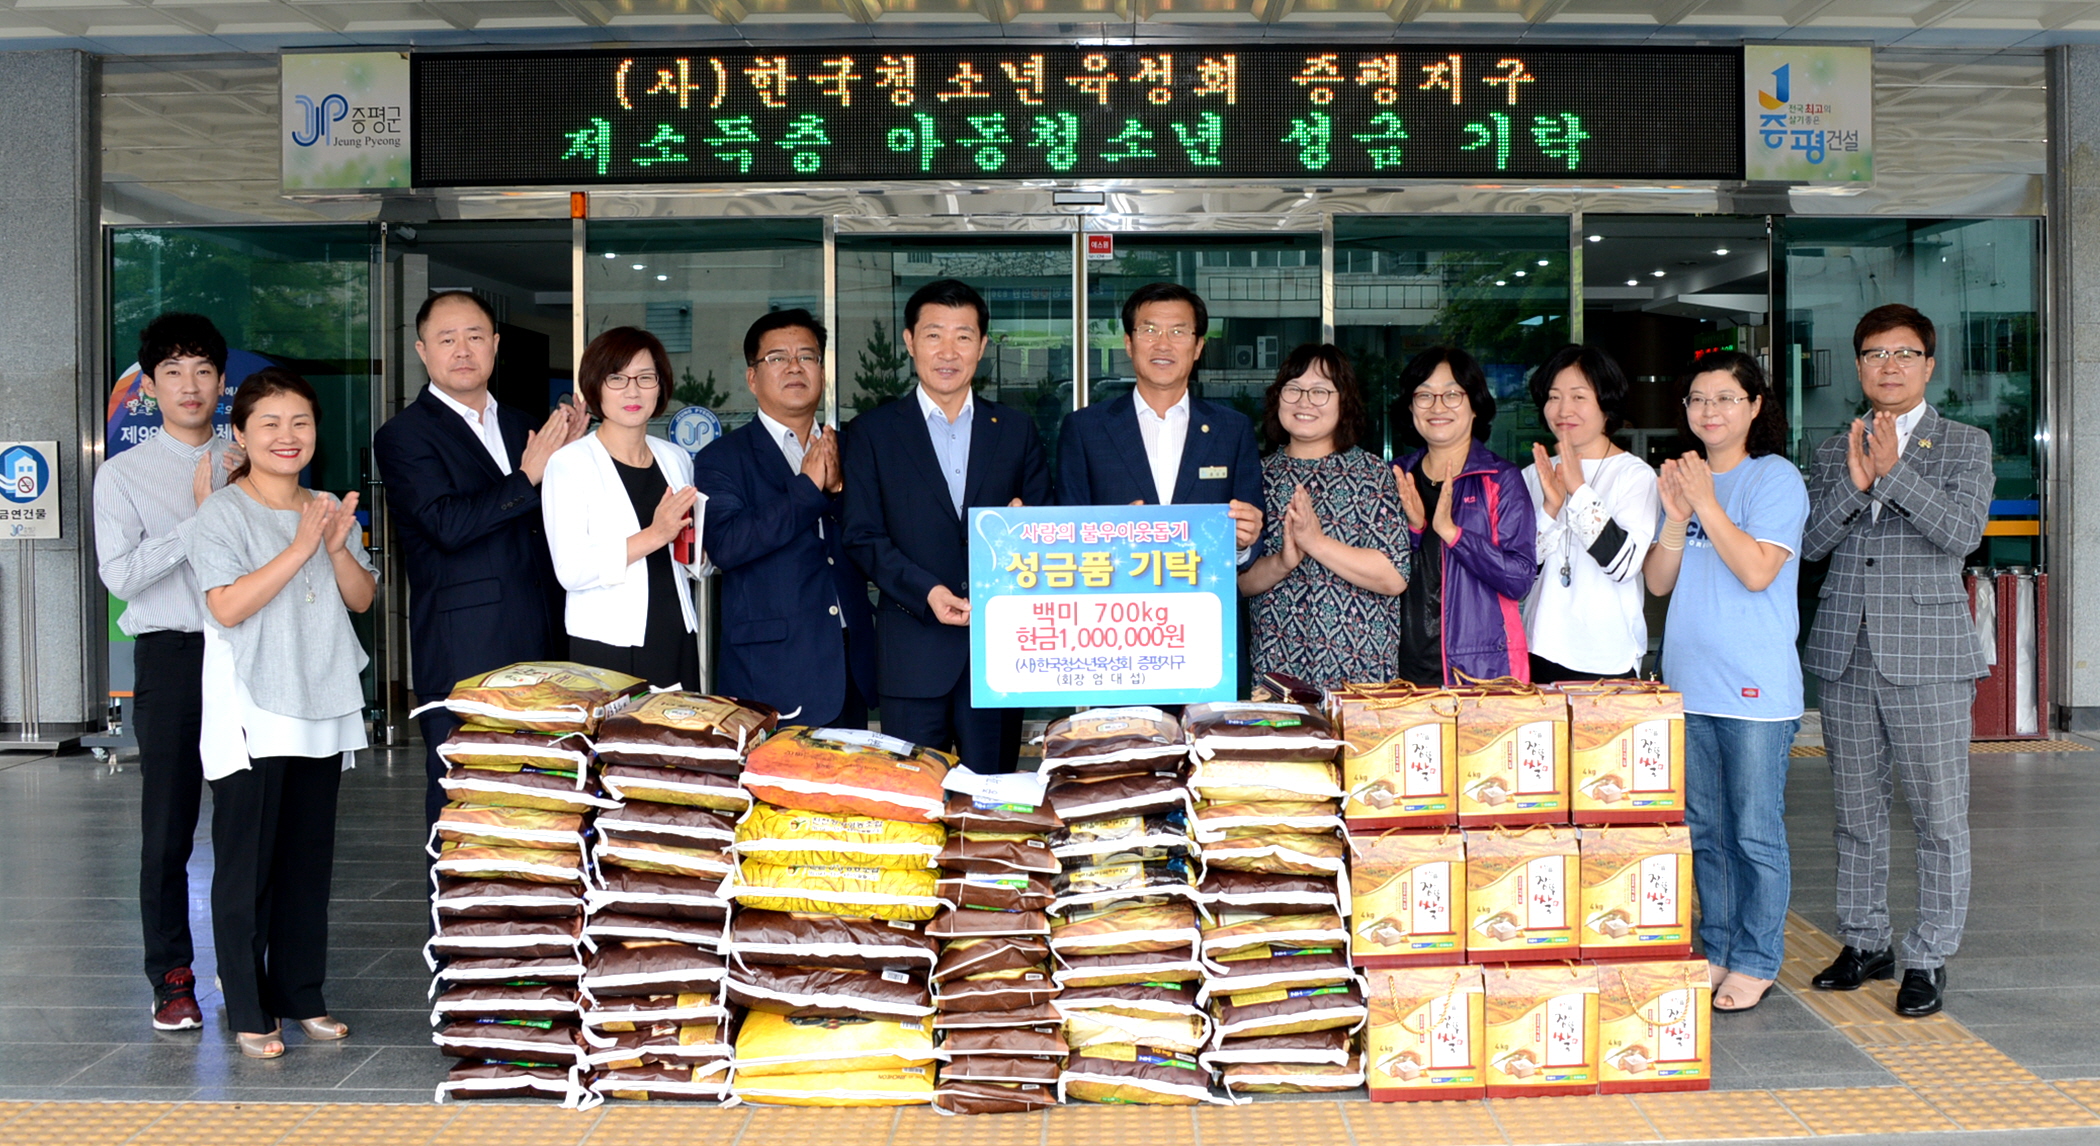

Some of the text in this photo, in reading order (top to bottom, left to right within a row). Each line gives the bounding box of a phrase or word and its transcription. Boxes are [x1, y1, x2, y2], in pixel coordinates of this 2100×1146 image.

[616, 53, 1535, 109] (사)한국청소년육성회 증평지구
[351, 106, 402, 135] 증평군
[333, 136, 401, 148] Jeung Pyeong
[887, 111, 1222, 172] 아동청소년
[1280, 111, 1411, 170] 성금
[1460, 111, 1591, 170] 기탁
[1021, 521, 1190, 543] 사랑의 불우이웃돕기
[1004, 549, 1203, 588] 성금품 기탁
[1032, 600, 1170, 627] 백미 700kg
[1015, 624, 1186, 652] 현금1,000,000원
[1014, 654, 1187, 674] (사)한국청소년육성회 증평지구
[1056, 672, 1146, 687] (회장 엄 대 섭)
